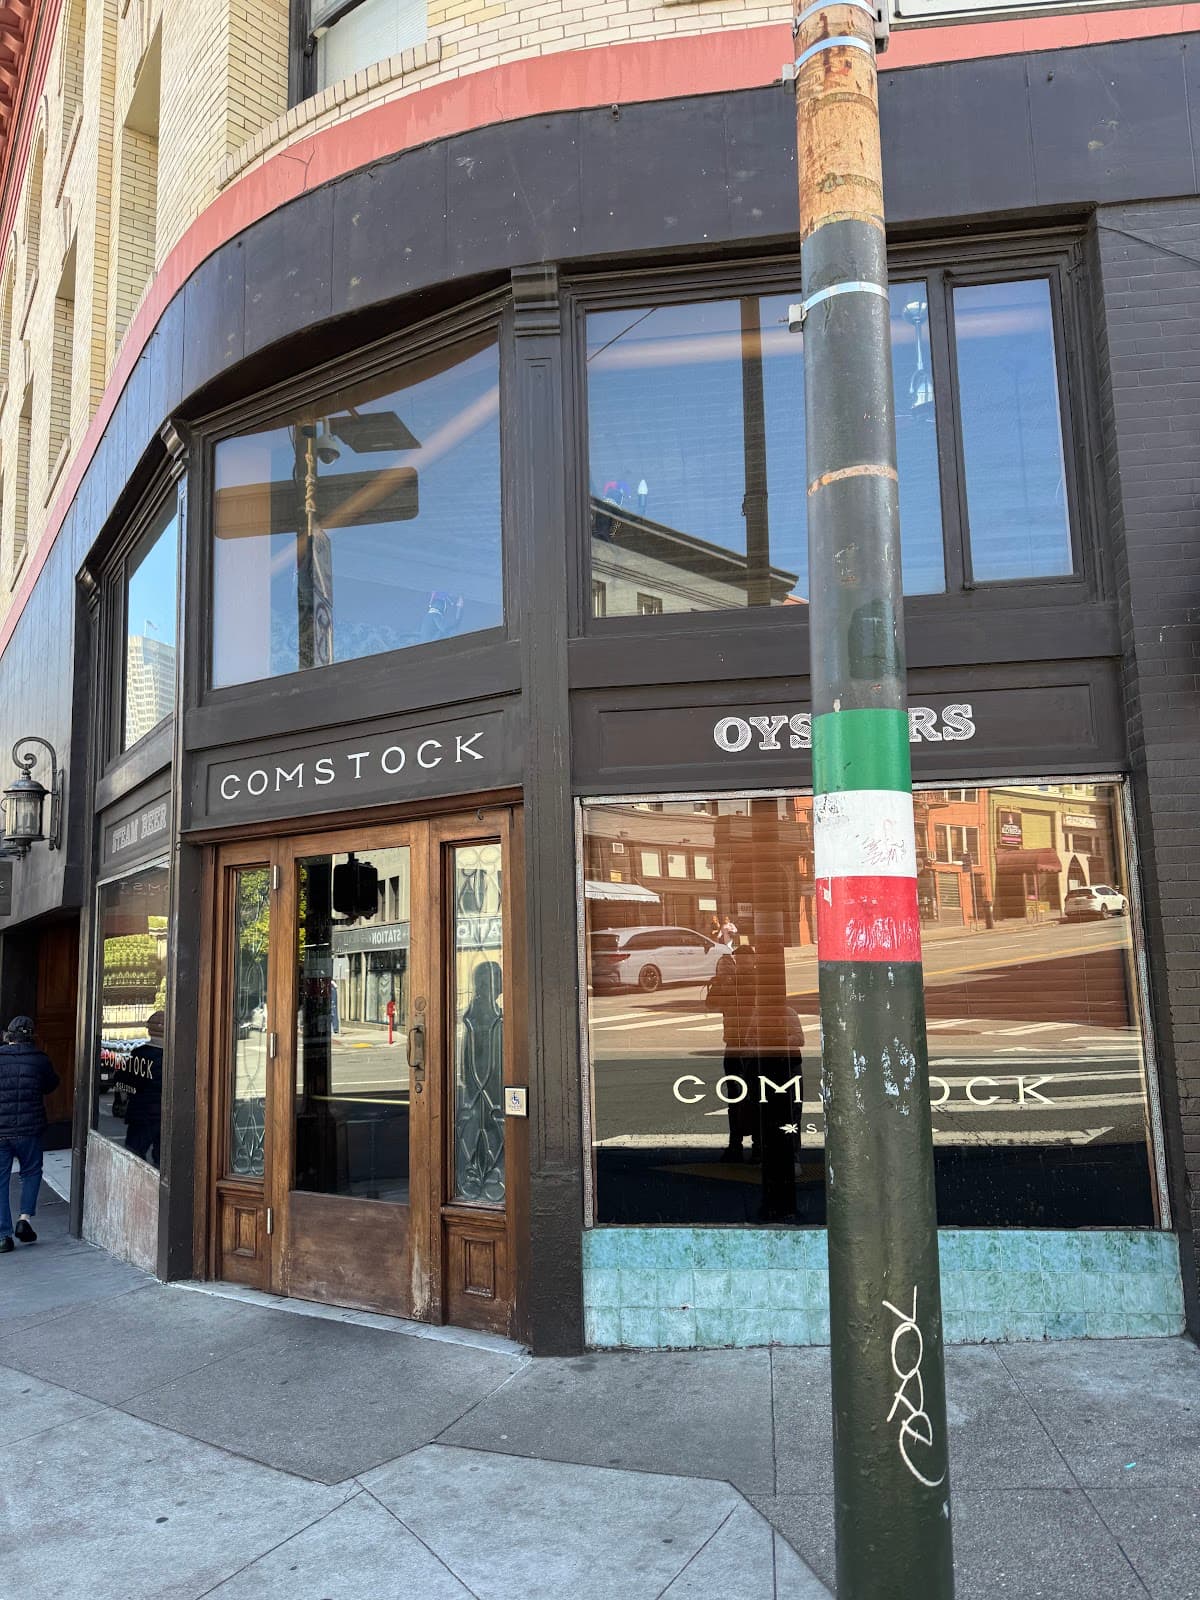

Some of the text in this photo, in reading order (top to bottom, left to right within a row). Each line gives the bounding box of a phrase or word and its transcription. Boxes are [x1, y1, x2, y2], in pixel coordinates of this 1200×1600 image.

[713, 703, 976, 753] OYSRS
[220, 732, 484, 800] COMSTOCK
[104, 1048, 154, 1080] COMSTOCK
[672, 1075, 1055, 1106] COMOCK
